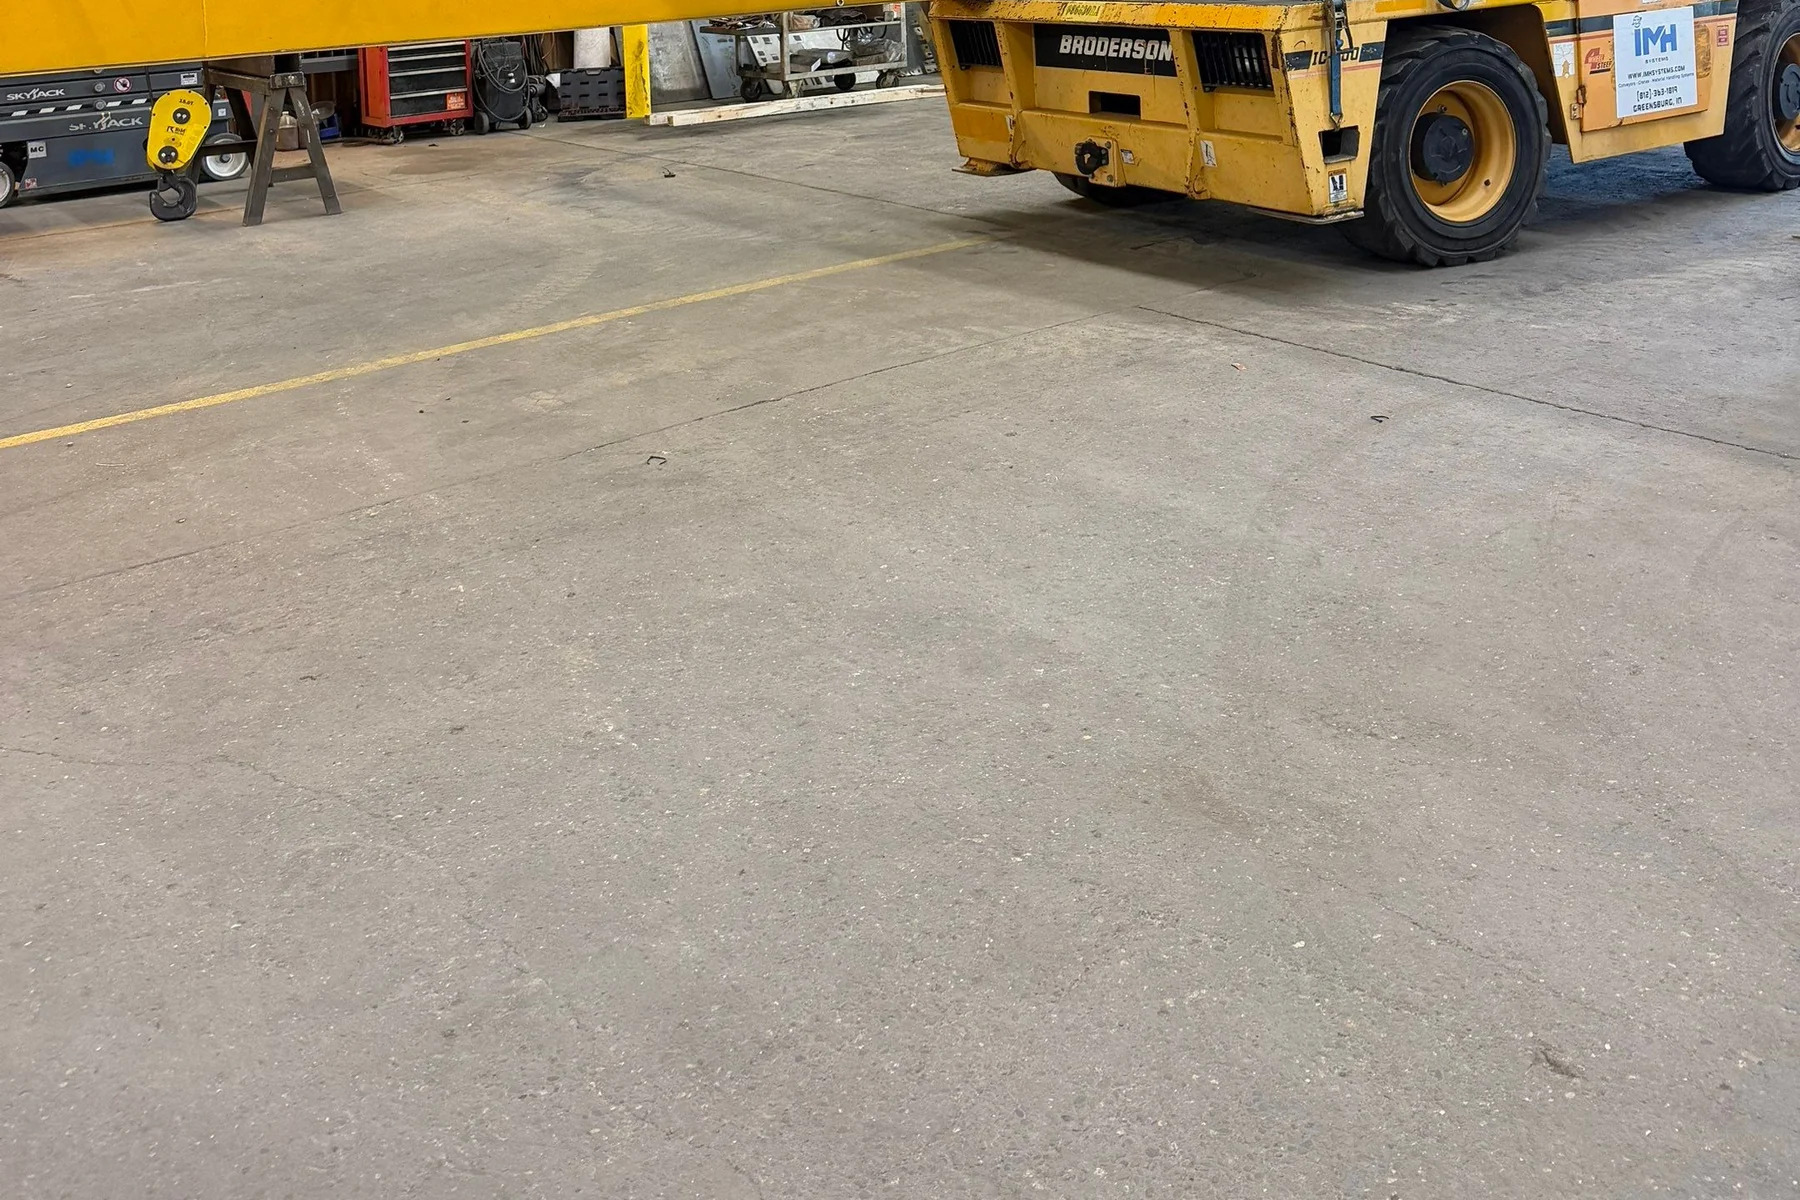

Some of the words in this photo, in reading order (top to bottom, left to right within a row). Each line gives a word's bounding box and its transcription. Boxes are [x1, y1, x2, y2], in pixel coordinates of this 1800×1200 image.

[1059, 35, 1173, 62] BRODERSON
[1634, 24, 1677, 57] IMH
[1645, 56, 1669, 64] SYSTEMS
[6, 88, 65, 101] SKYJACK
